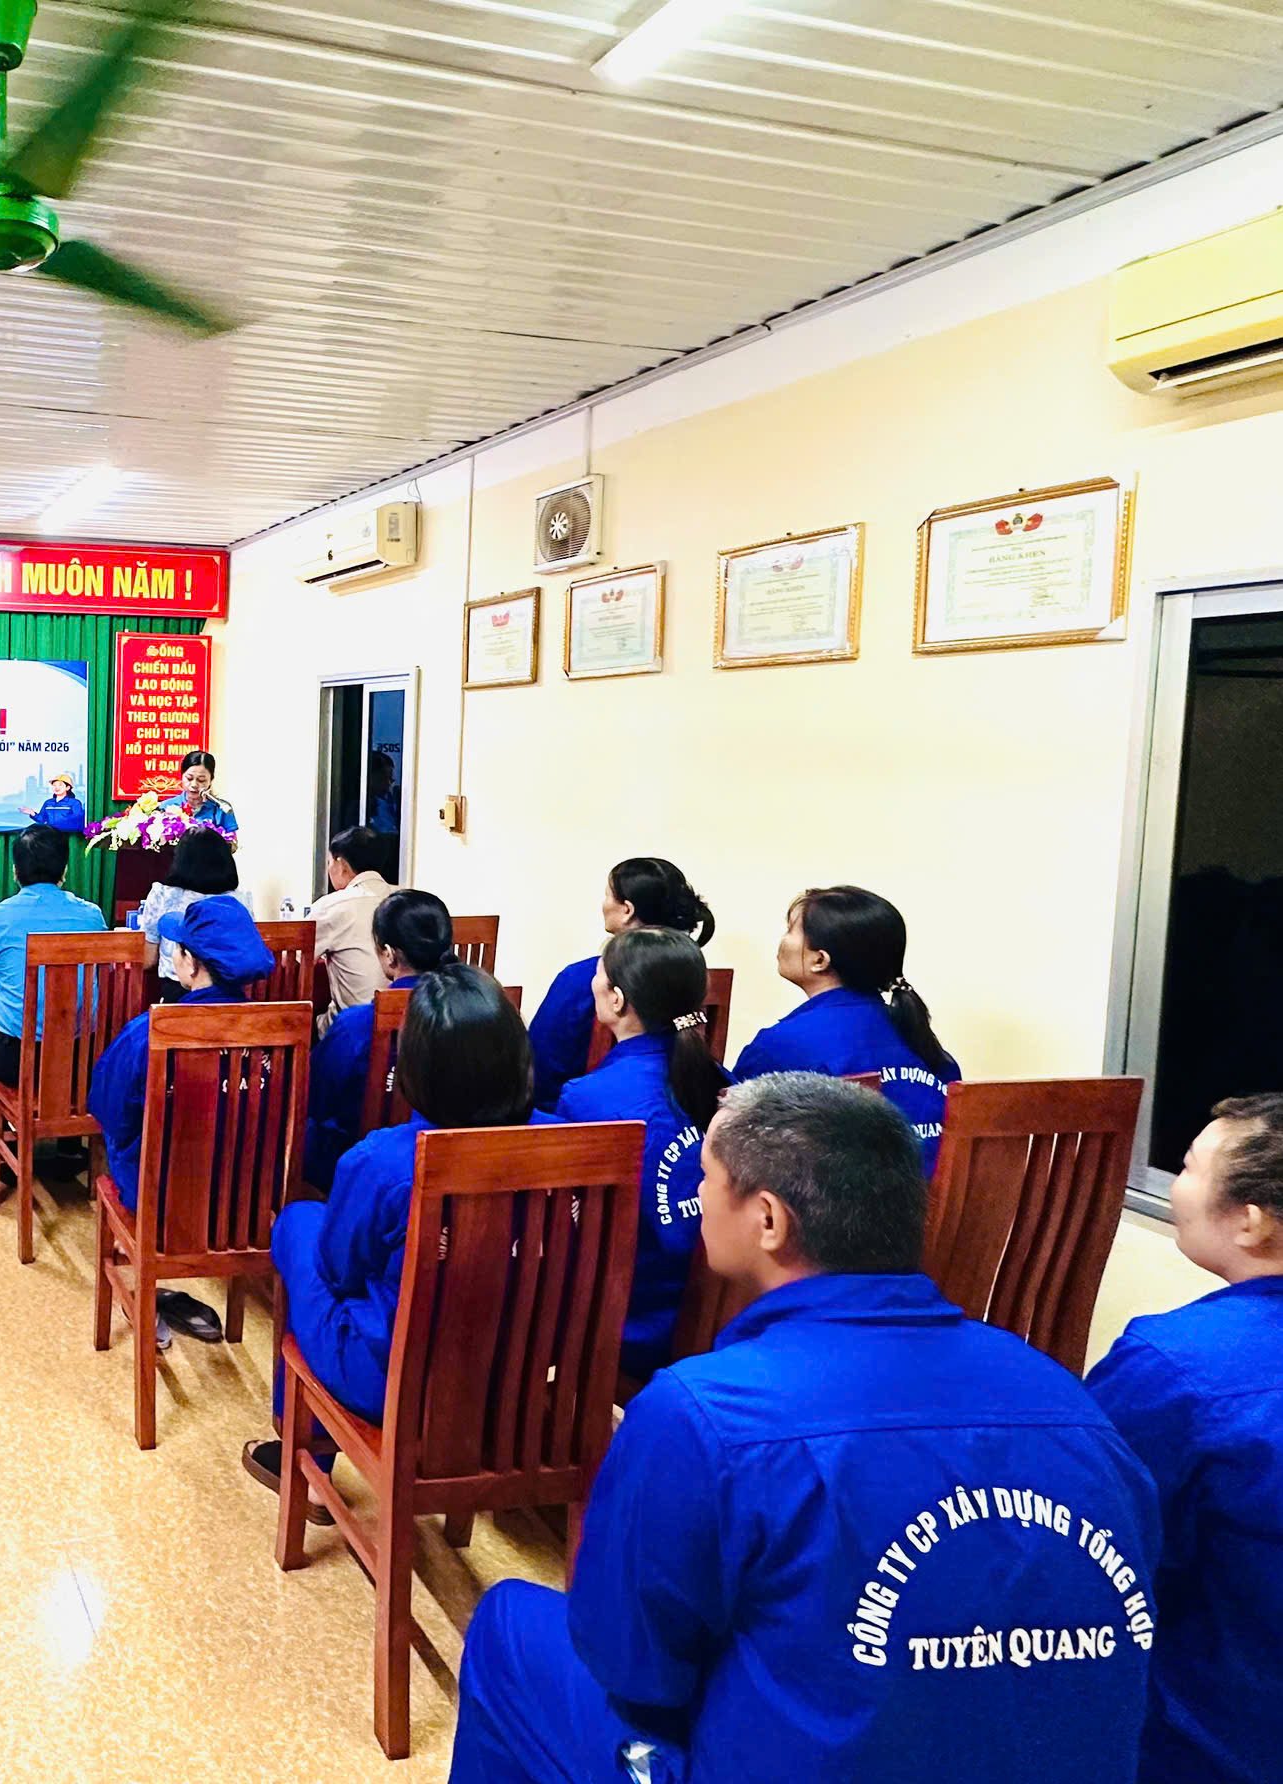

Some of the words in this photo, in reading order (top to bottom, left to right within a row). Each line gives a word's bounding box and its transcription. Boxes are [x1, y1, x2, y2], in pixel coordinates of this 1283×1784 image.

[21, 557, 104, 597] MUÔN
[112, 561, 175, 600] NĂM
[185, 569, 193, 600] !
[133, 660, 169, 674] CHIẾN
[135, 678, 158, 691] LAO
[160, 677, 193, 692] ĐỘNG
[130, 693, 145, 706] VÀ
[148, 695, 172, 709] HỌC
[175, 694, 197, 709] TẬP
[127, 711, 156, 722] THEO
[159, 711, 199, 723] GƯƠNG
[136, 724, 160, 739] CHỦ
[163, 728, 189, 742] TỊCH
[18, 740, 42, 752] NĂM
[44, 742, 69, 752] 2026
[125, 740, 142, 755] HỒ
[144, 742, 165, 755] CHÍ
[144, 758, 157, 771] VĨ
[159, 760, 179, 774] ĐẠI
[900, 1067, 935, 1087] DỰNG
[664, 1141, 681, 1163] CP
[657, 1160, 672, 1180] TY
[677, 1196, 703, 1218] TUY
[847, 1581, 900, 1667] CÔNG
[877, 1541, 917, 1584] TY
[905, 1511, 938, 1554] CP
[938, 1485, 990, 1530] XÂY
[992, 1487, 1071, 1537] DỰNG
[1078, 1518, 1136, 1593] TỔNG
[1123, 1591, 1154, 1651] HỢP
[908, 1625, 1004, 1670] TUYÊN
[1008, 1625, 1117, 1668] QUANG
